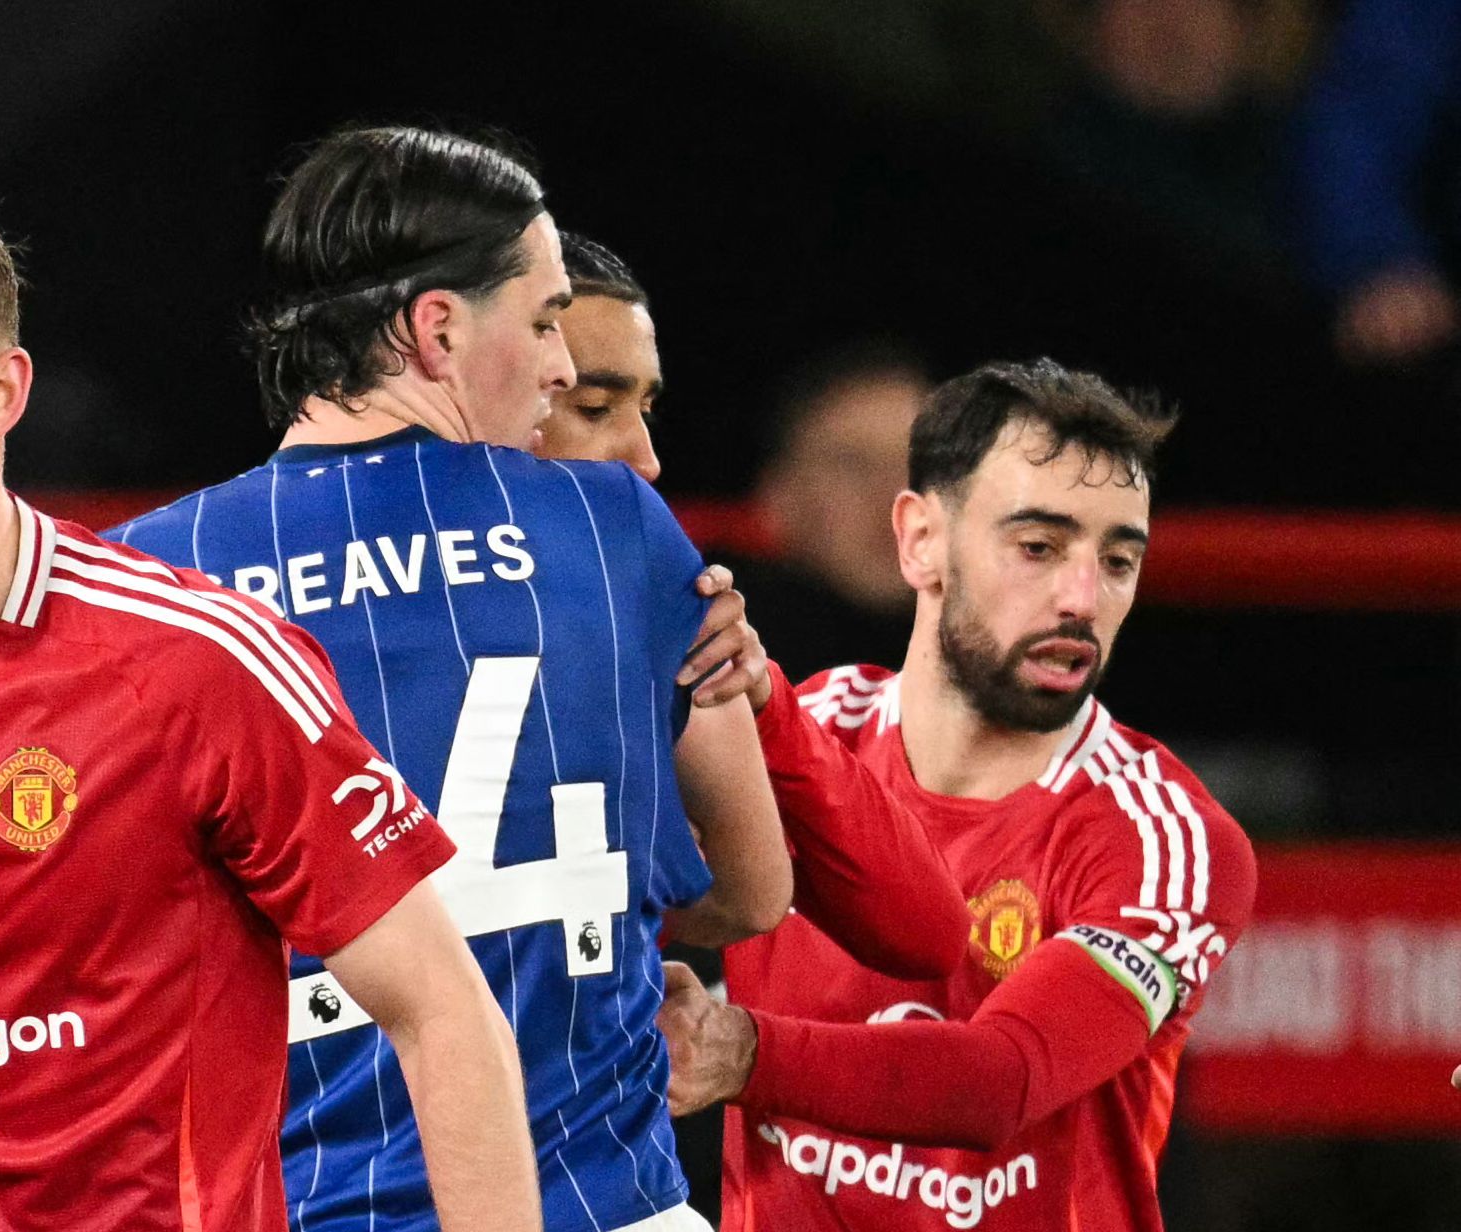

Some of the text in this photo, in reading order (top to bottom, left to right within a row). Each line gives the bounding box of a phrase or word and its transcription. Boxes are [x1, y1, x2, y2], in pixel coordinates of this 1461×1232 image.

[209, 523, 536, 618] REAVES
[5, 826, 59, 845] UNITED
[1073, 924, 1162, 1001] aptain
